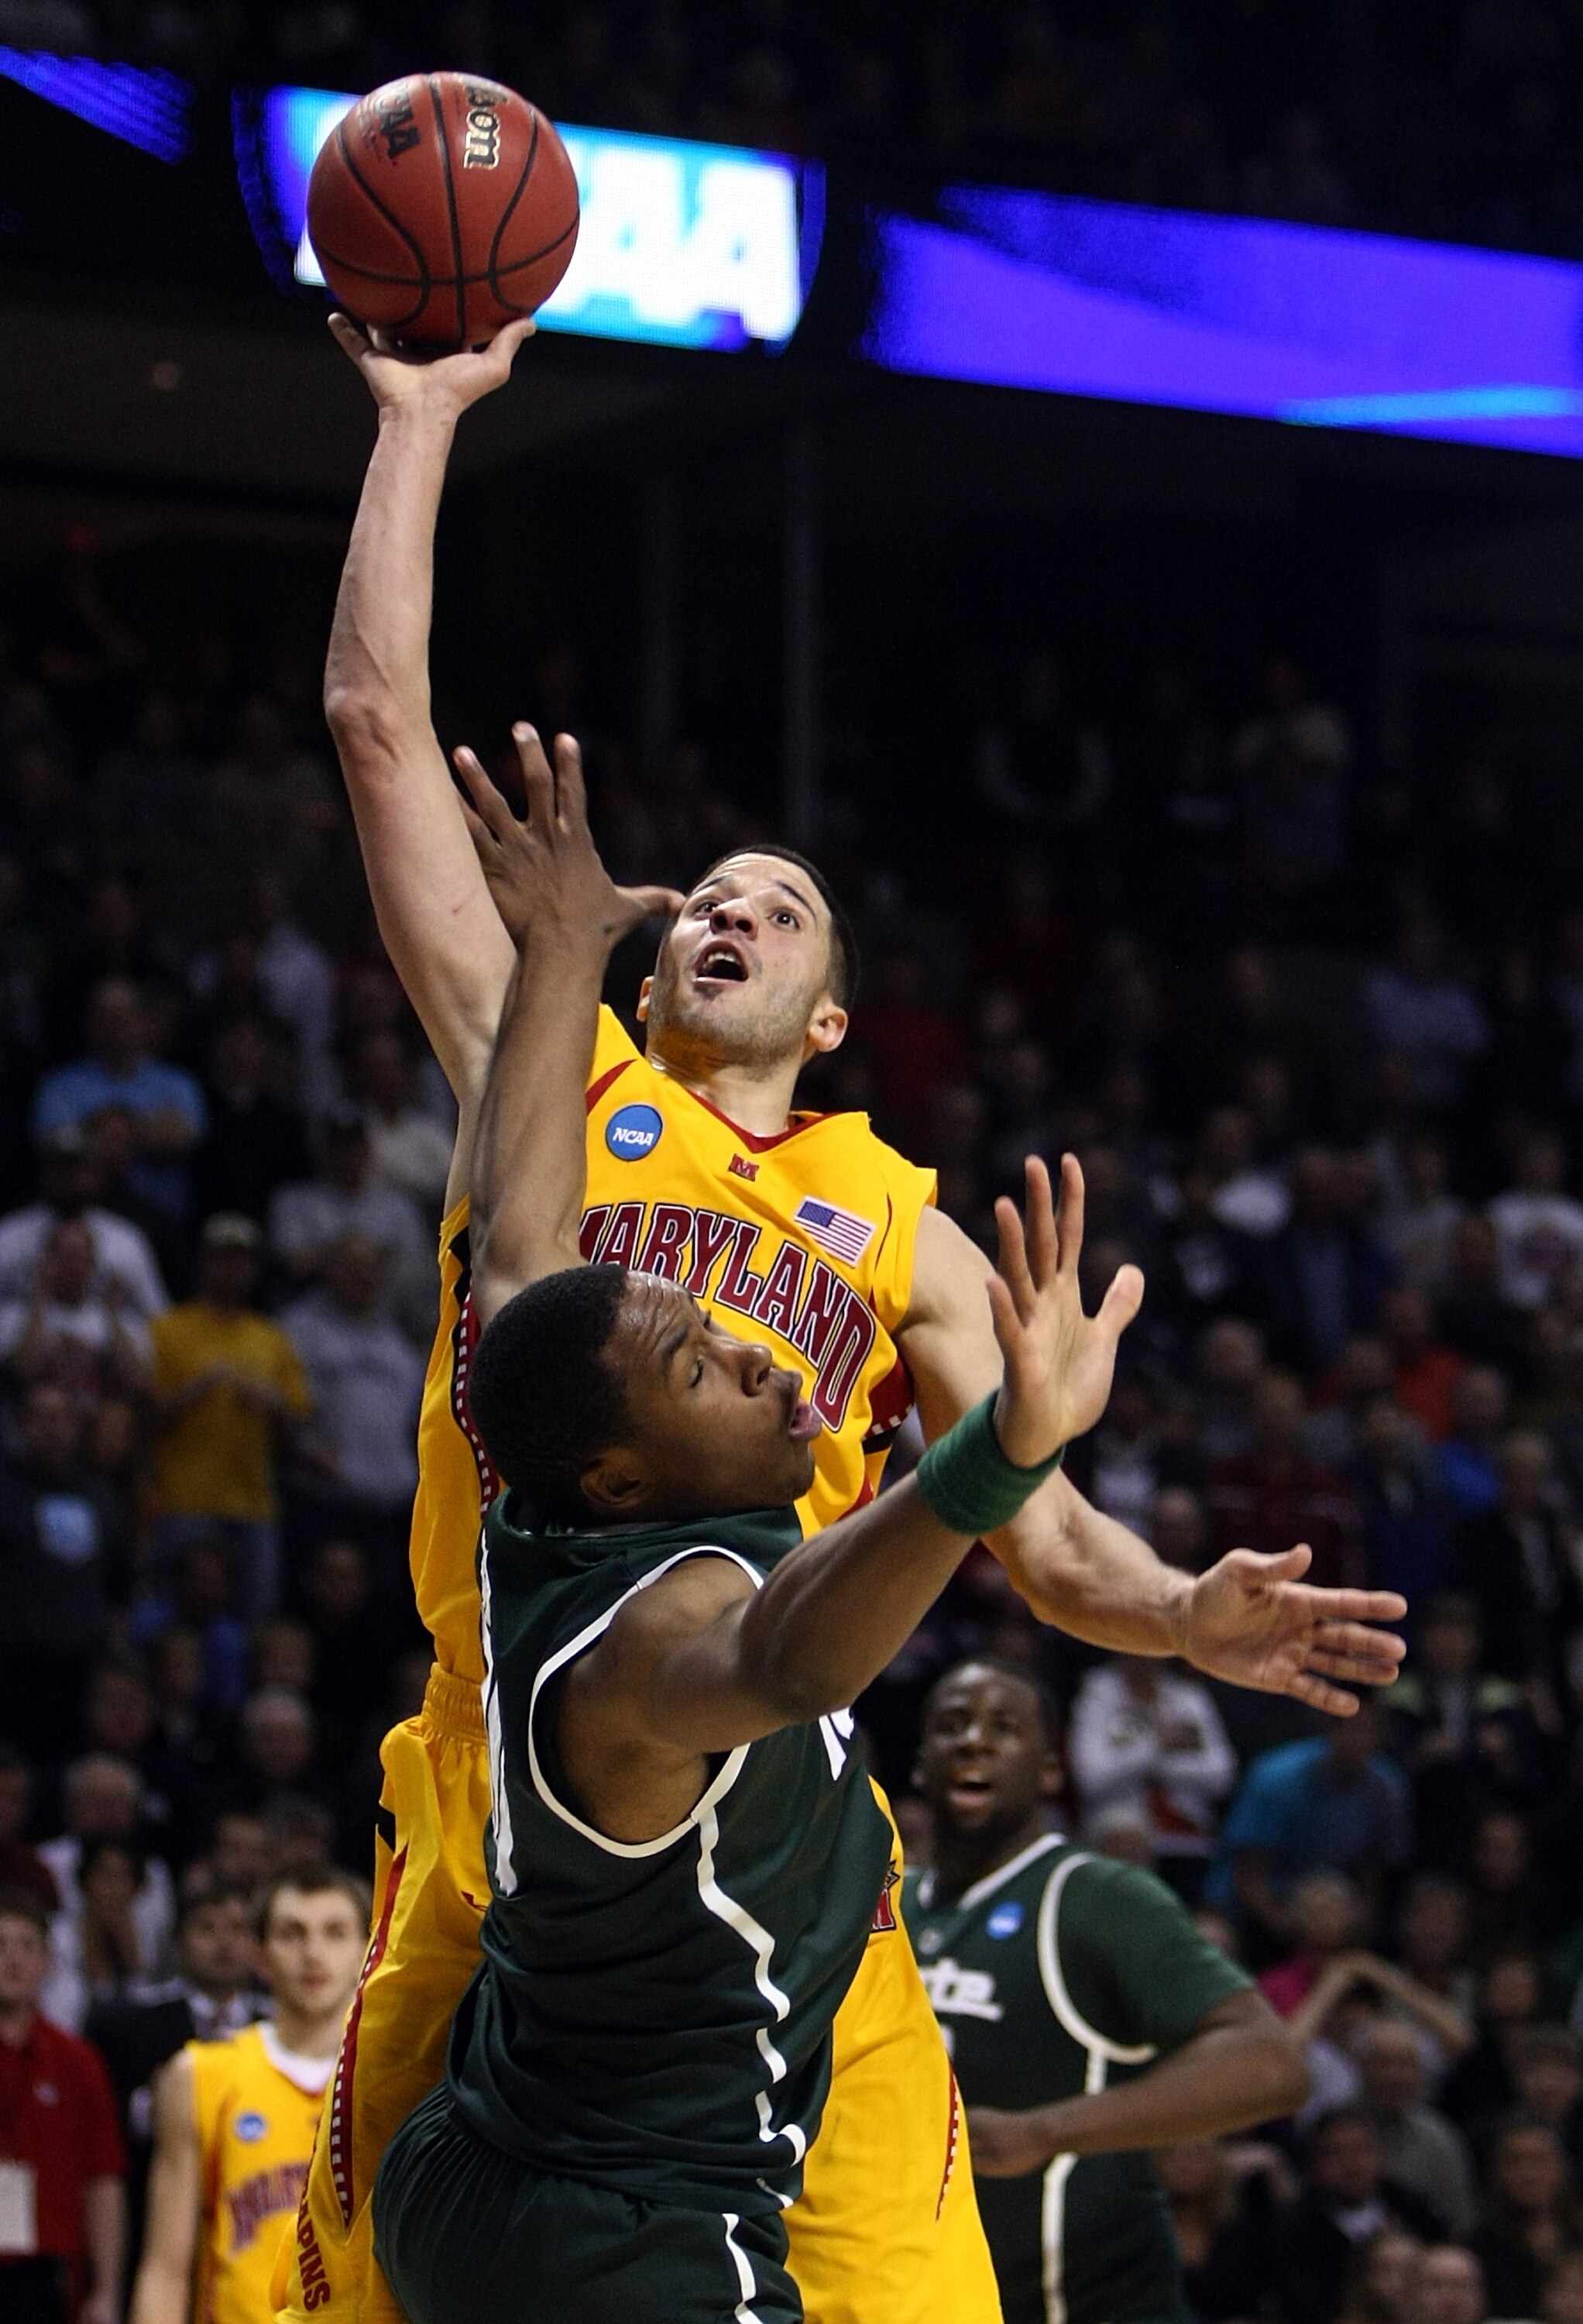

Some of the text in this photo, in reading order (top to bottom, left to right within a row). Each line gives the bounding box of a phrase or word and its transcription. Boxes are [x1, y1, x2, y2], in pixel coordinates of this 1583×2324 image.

[464, 84, 508, 170] son
[612, 1126, 654, 1147] NCAA
[728, 1153, 760, 1182] M
[922, 1957, 1004, 2023] te
